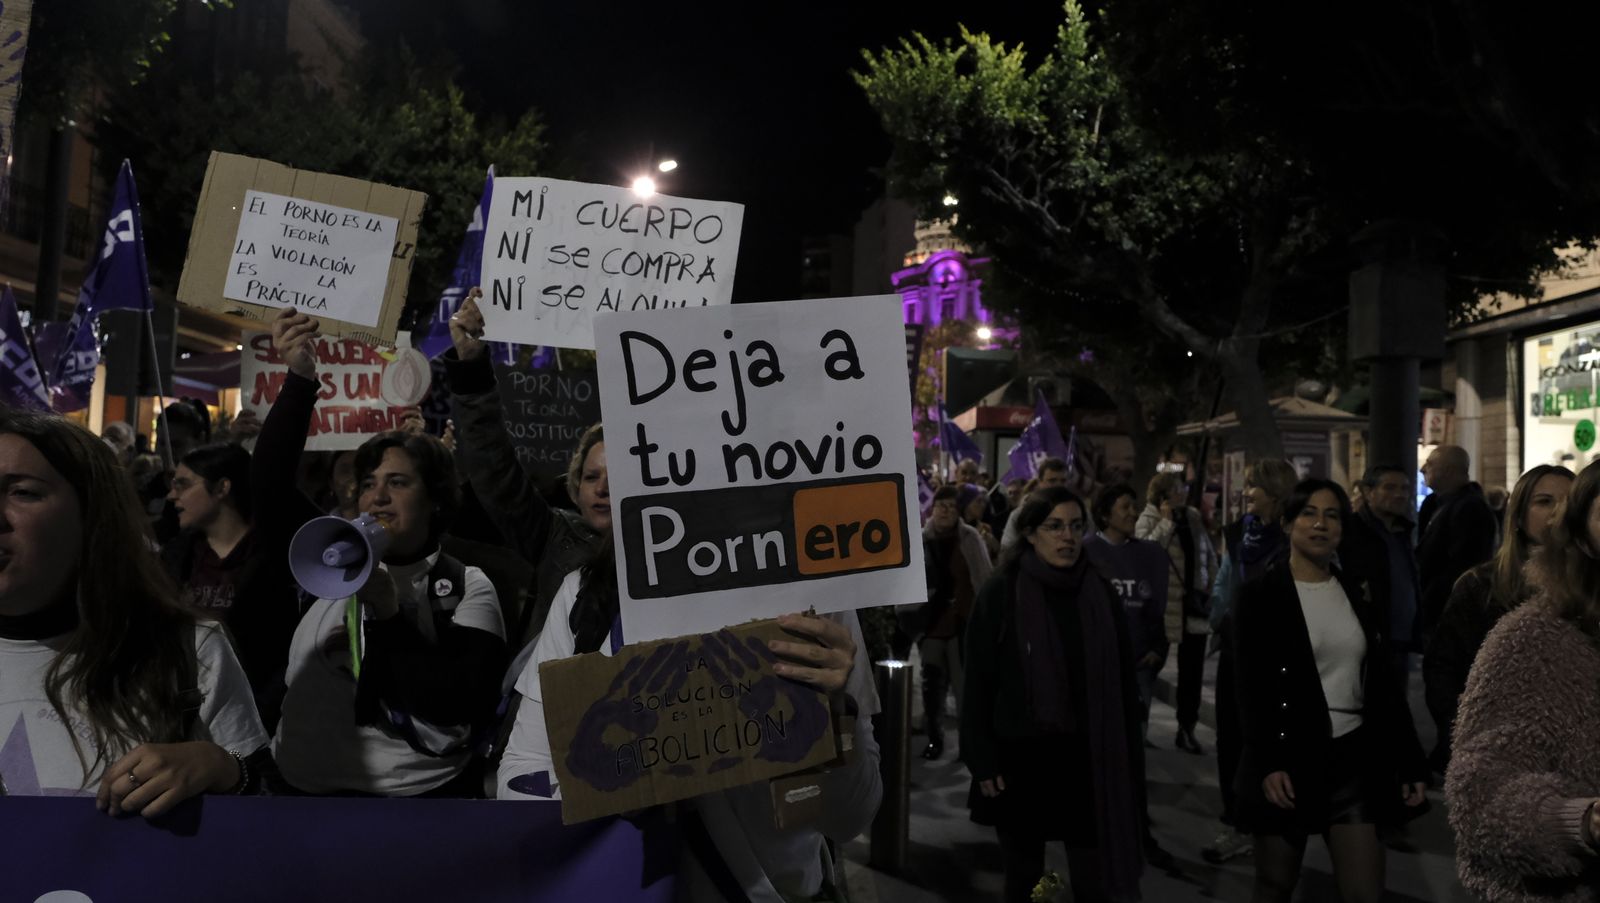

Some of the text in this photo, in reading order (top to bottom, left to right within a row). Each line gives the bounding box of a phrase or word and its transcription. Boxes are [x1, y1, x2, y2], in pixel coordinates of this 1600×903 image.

[248, 196, 382, 232] EL PORNO ES LA
[576, 200, 723, 244] CUERPO
[235, 240, 356, 275] LA VIOLACIÓN
[602, 248, 715, 284] COMPRA
[237, 262, 337, 290] ES LA
[245, 279, 328, 311] PRÁCTICA
[344, 372, 380, 401] UN
[508, 371, 592, 401] PORNO
[620, 329, 785, 436] Deja
[820, 329, 865, 380] a
[629, 421, 883, 486] tu novio
[685, 657, 708, 673] LA
[672, 706, 713, 722] ES LA
